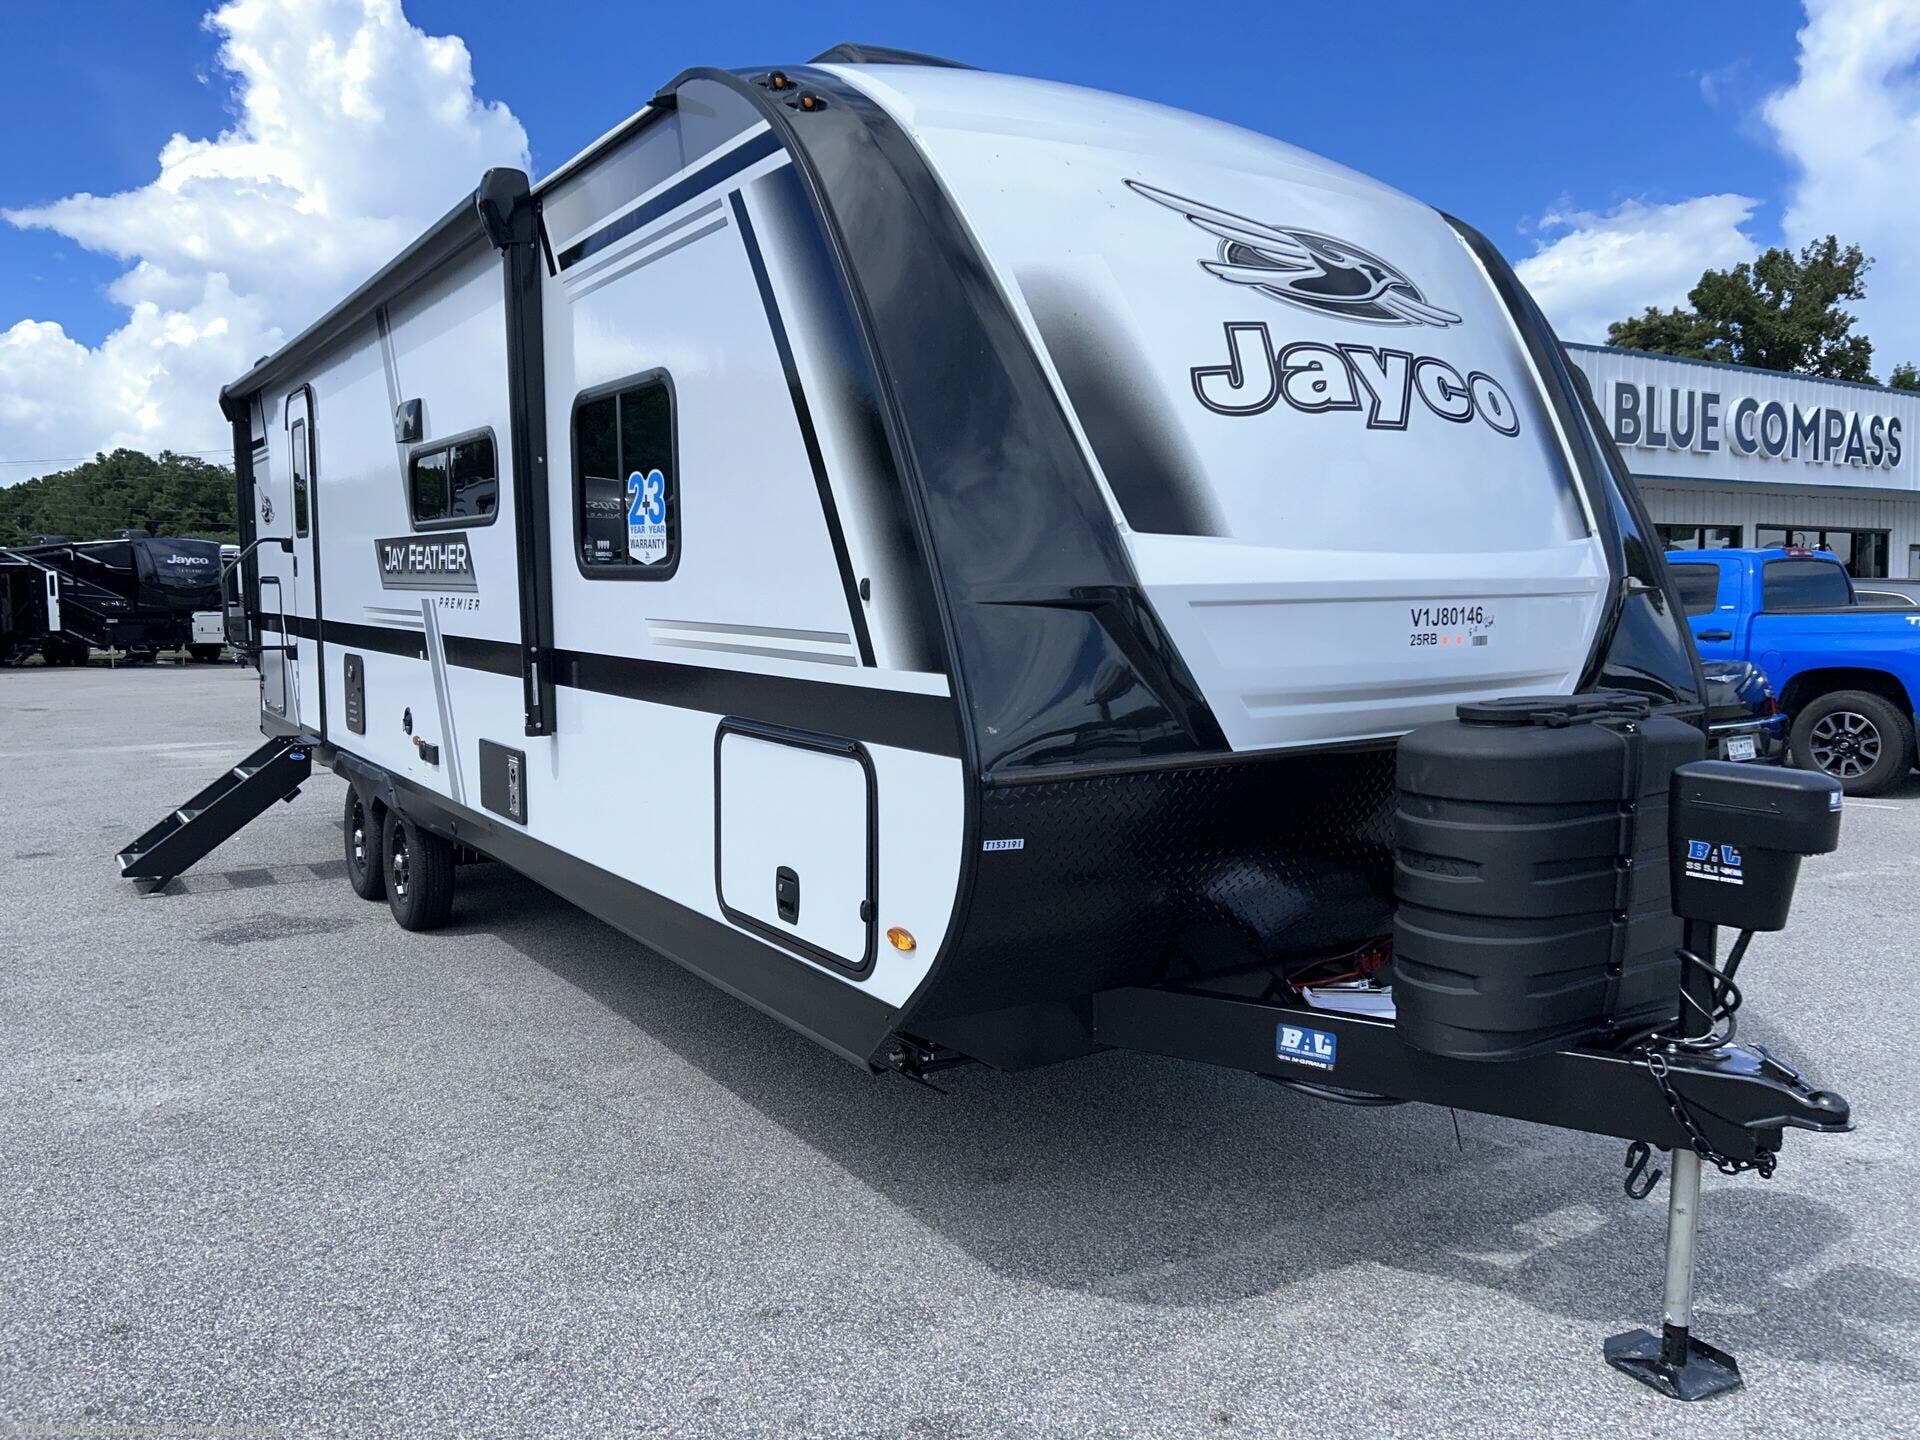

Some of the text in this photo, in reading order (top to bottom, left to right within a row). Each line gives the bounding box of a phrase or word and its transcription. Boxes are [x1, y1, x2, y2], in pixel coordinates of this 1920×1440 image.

[1190, 321, 1519, 437] Jayco
[1613, 380, 1902, 468] BLUE COMPASS
[630, 525, 665, 534] YEAR YEAR
[630, 538, 665, 550] WARRANTY
[167, 554, 209, 566] Jayco
[384, 543, 467, 571] JAY FEATHER
[439, 597, 480, 611] PREMIER
[1410, 606, 1483, 627] V1J80146
[1410, 633, 1438, 646] 25RB
